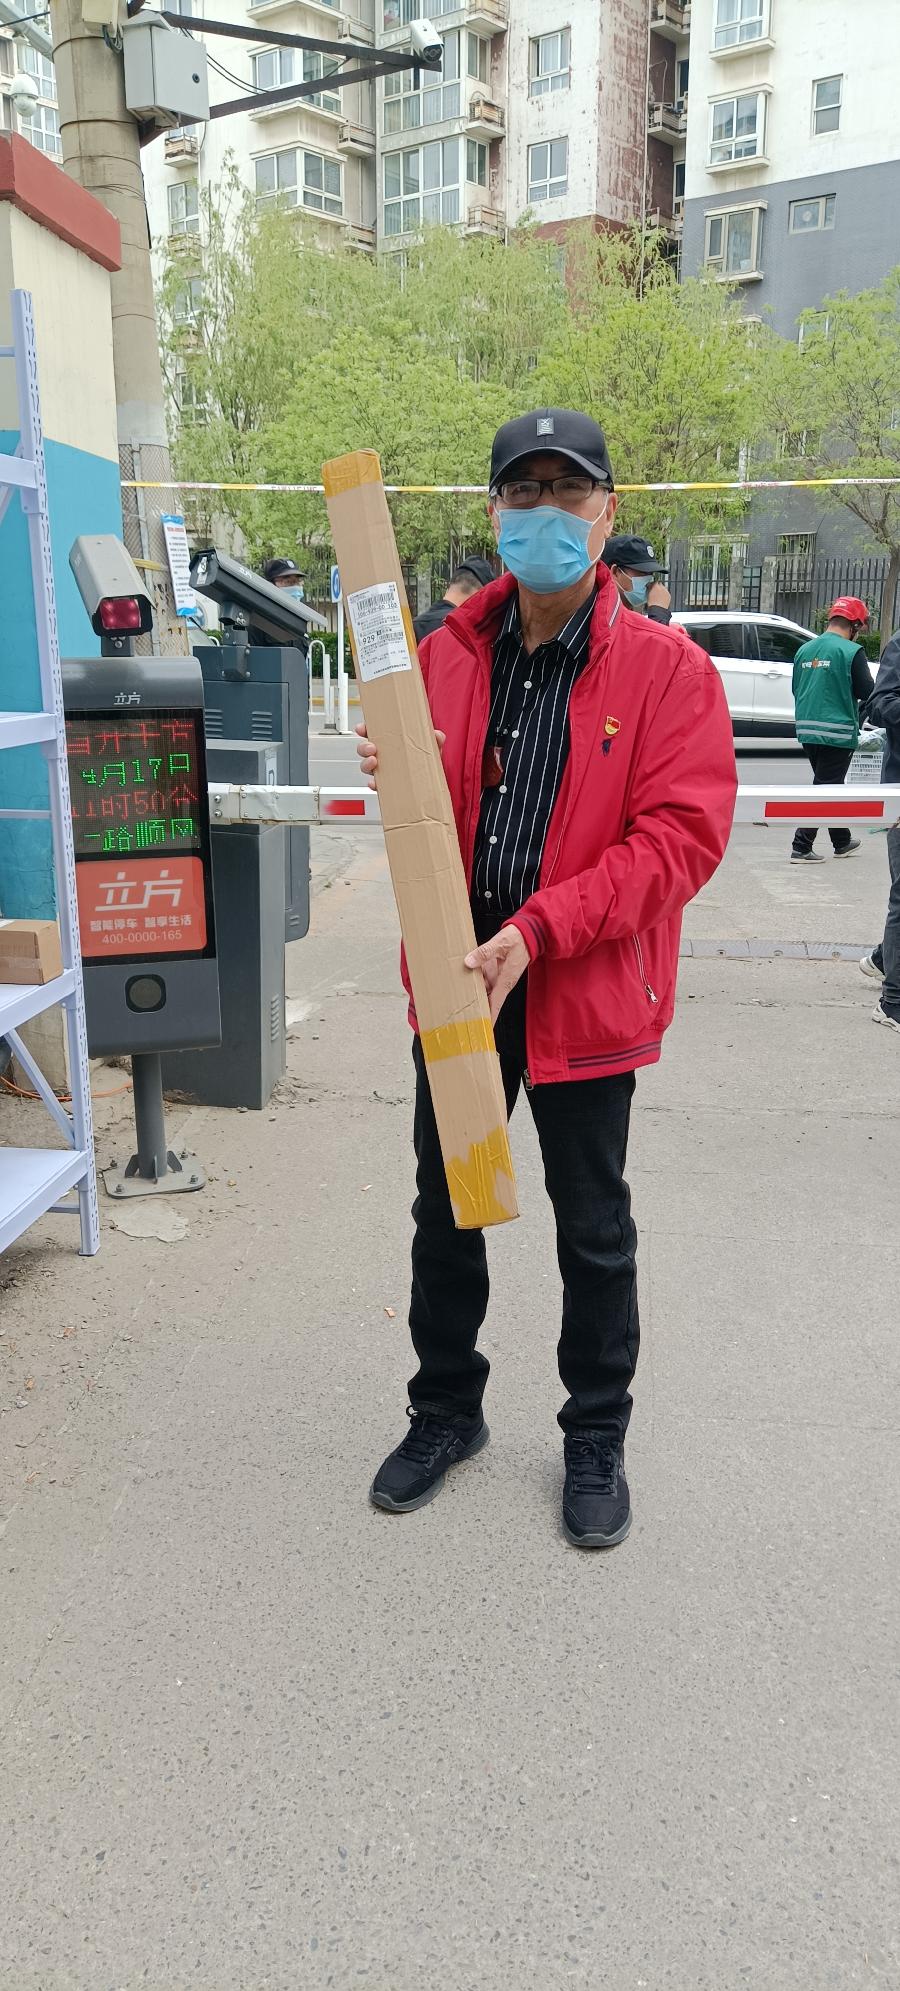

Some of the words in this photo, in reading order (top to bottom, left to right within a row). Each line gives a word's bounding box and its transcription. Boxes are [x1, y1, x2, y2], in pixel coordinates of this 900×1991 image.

[362, 634, 375, 645] 929
[113, 691, 141, 705] 立方
[95, 870, 183, 912] 立方
[90, 918, 137, 932] 智能停车
[144, 914, 192, 928] 智享生活
[102, 929, 182, 944] 400-0000-165
